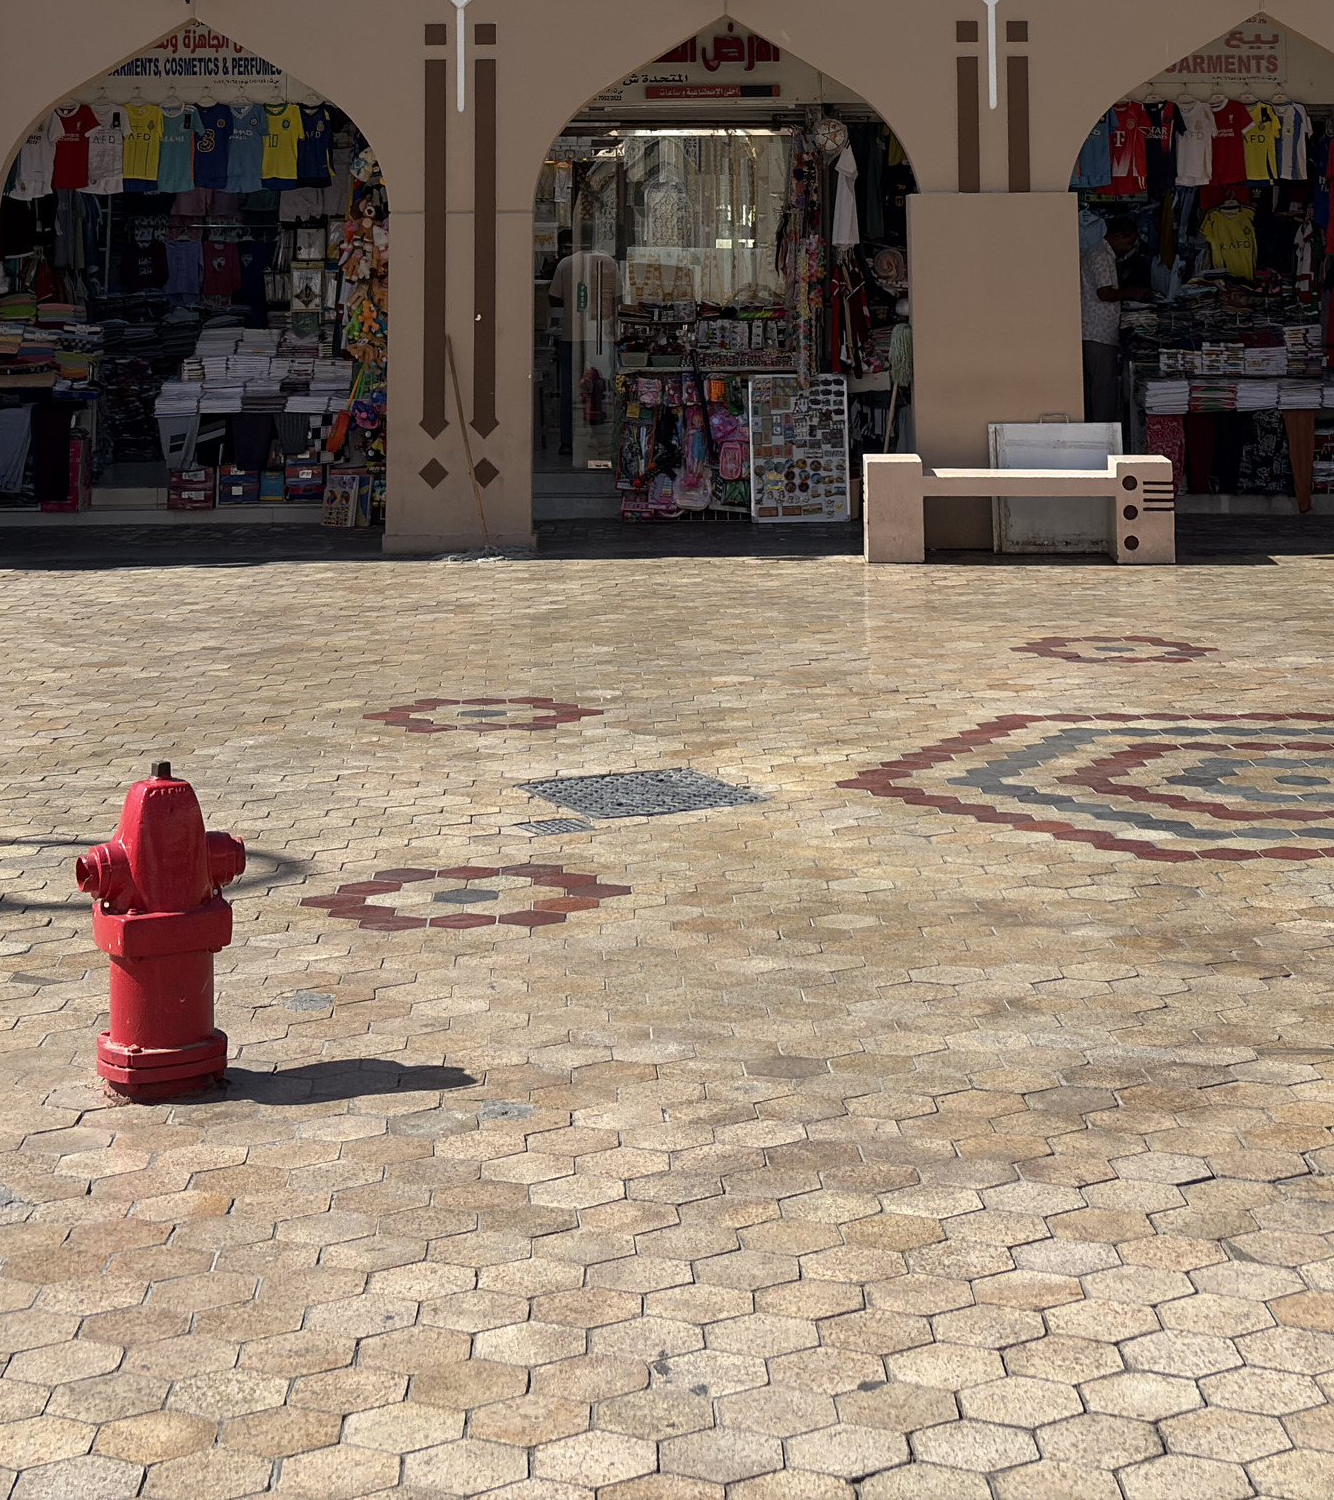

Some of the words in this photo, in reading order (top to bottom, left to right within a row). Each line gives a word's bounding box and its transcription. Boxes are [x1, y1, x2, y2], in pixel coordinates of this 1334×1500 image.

[1224, 31, 1279, 50] بيع
[164, 57, 219, 77] COSMETICS
[222, 57, 229, 76] &
